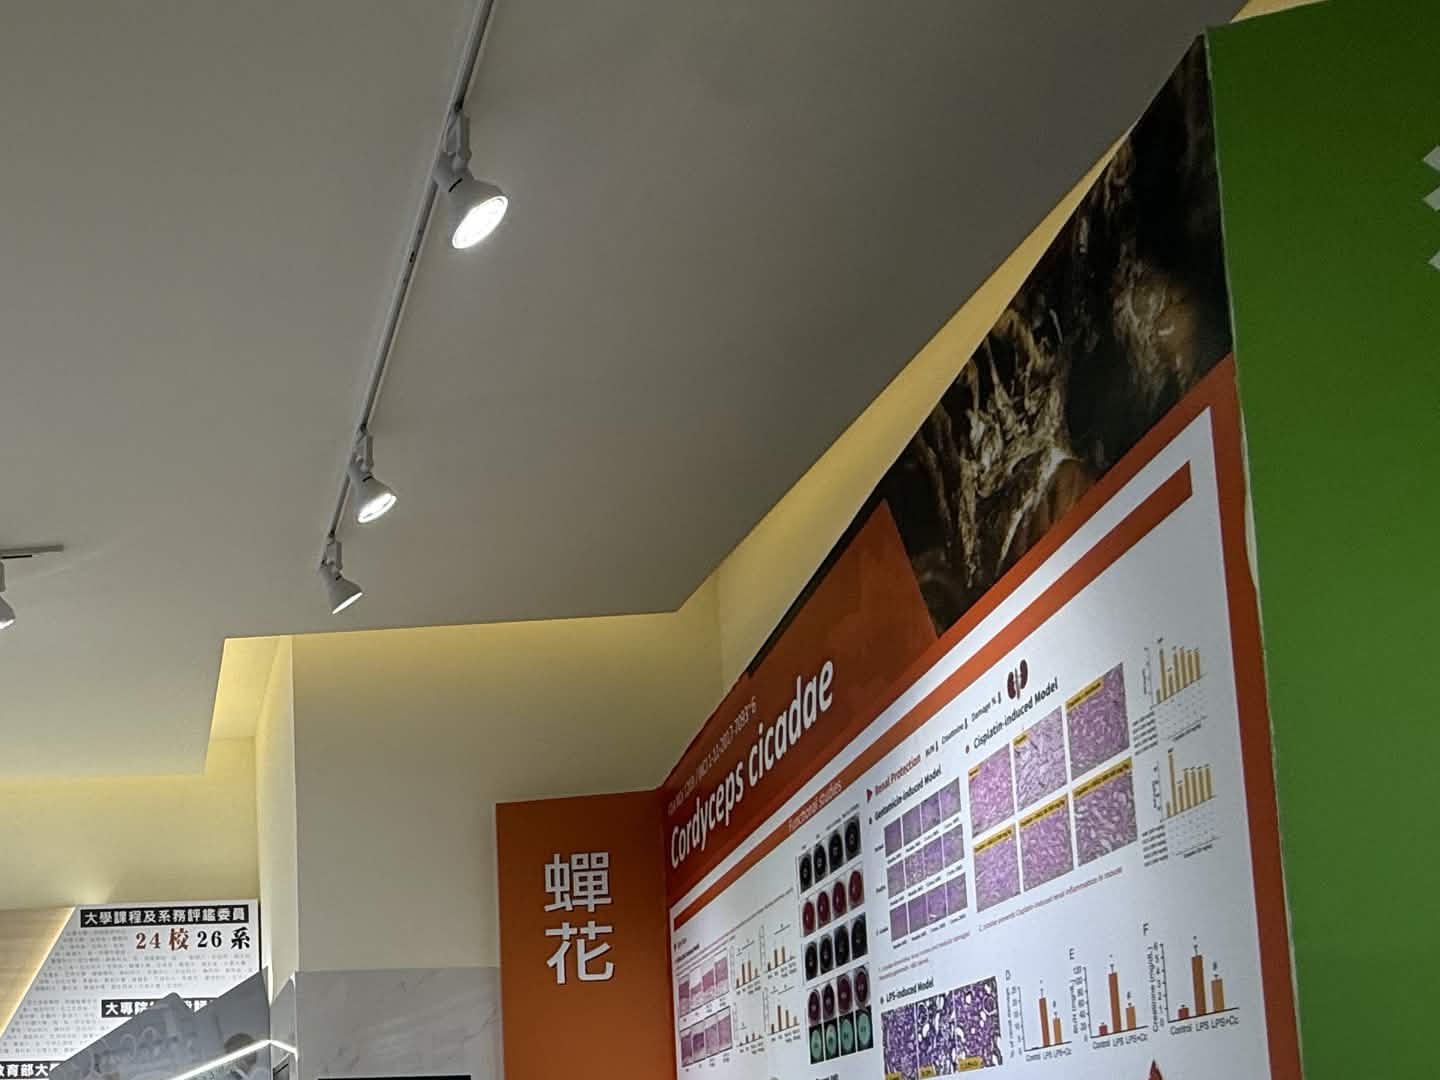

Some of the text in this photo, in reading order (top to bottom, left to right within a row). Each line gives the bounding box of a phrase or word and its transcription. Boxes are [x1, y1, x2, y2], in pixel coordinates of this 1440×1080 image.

[1034, 677, 1059, 706] Model
[671, 761, 744, 869] Cordyceps
[748, 660, 834, 787] cicadae
[543, 852, 615, 985] 蟬花
